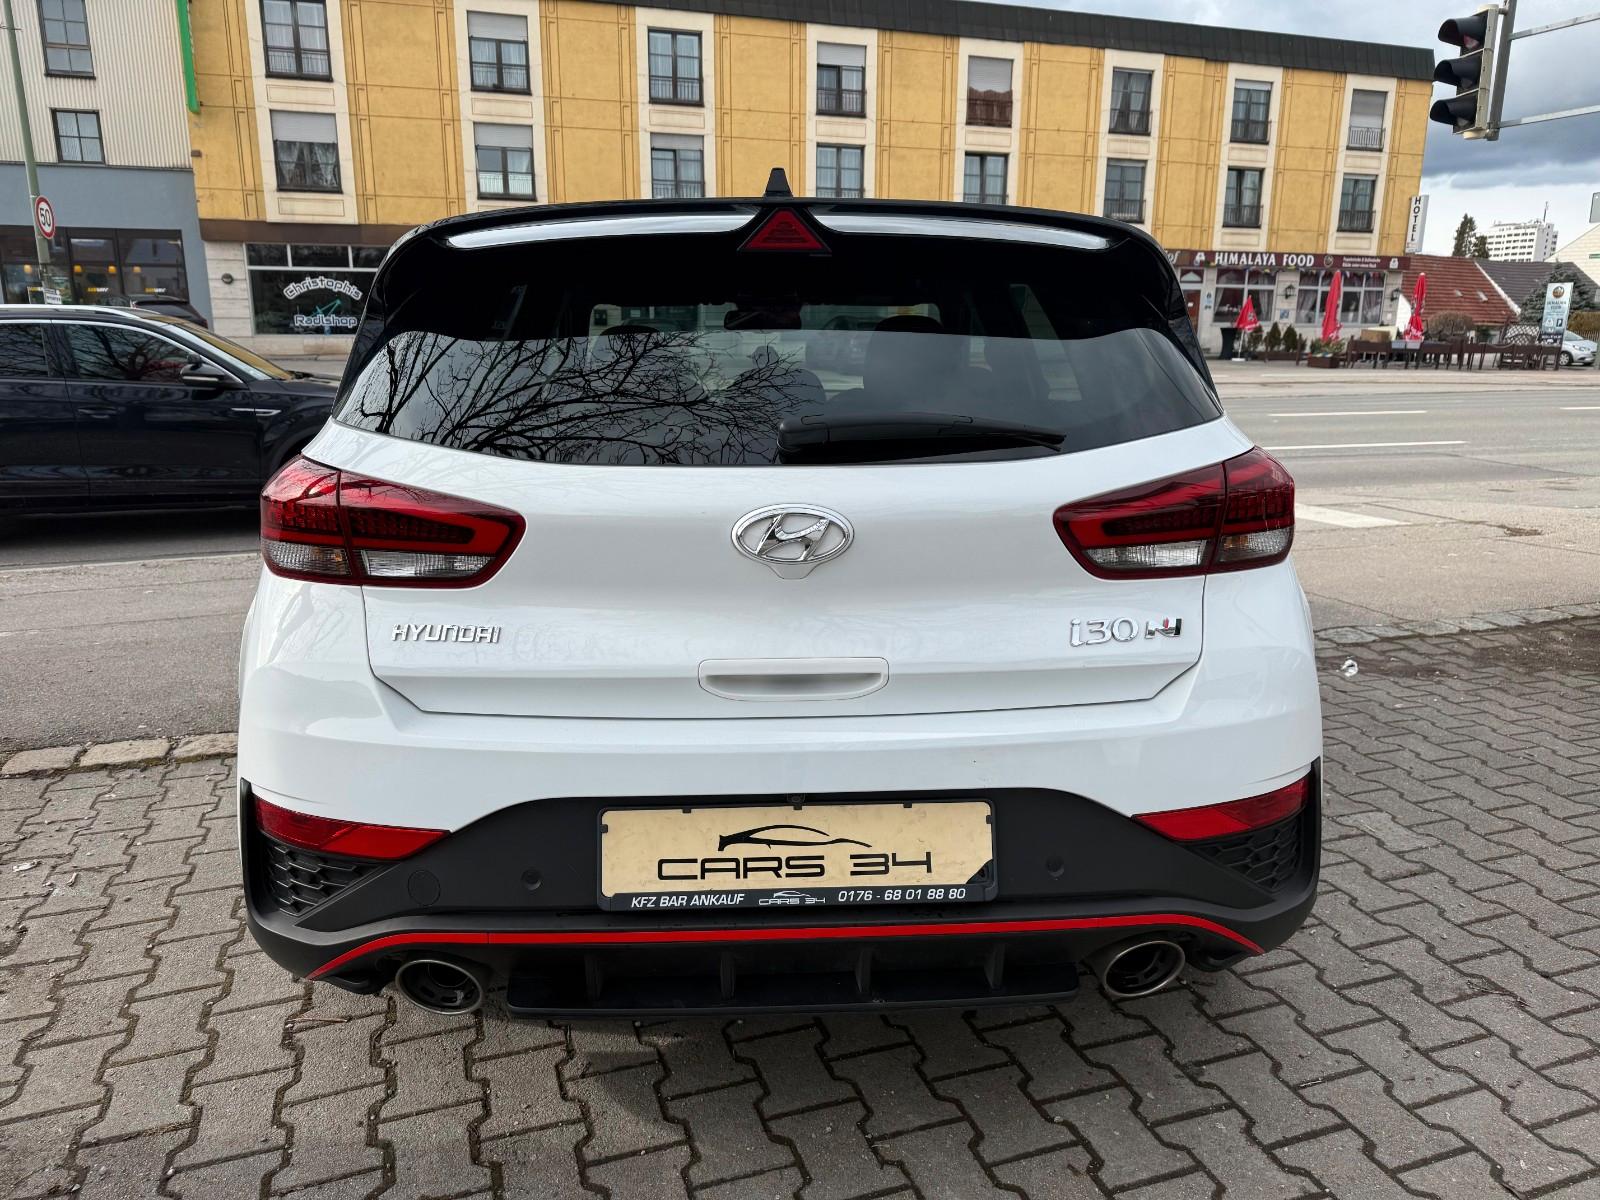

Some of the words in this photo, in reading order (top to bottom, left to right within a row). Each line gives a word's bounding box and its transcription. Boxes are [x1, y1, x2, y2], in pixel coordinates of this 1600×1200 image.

[39, 207, 51, 227] 50
[1410, 195, 1422, 242] HOTEL
[1215, 252, 1276, 265] HIMALAYA
[1283, 254, 1315, 267] FOOD
[283, 276, 363, 300] Christoph's
[294, 313, 358, 329] Radlshop
[391, 623, 501, 643] HYUNDAI
[1070, 617, 1139, 647] i30
[657, 855, 825, 881] CARS
[849, 851, 932, 877] 34
[631, 896, 657, 908] KFZ
[659, 895, 688, 907] BAR
[690, 893, 745, 906] ANKAUF
[758, 896, 800, 905] CARS
[804, 896, 826, 905] 34
[838, 890, 873, 902] 0176
[884, 889, 902, 901] 68
[905, 889, 922, 900] 01
[926, 888, 945, 900] 88
[948, 888, 966, 899] 80
